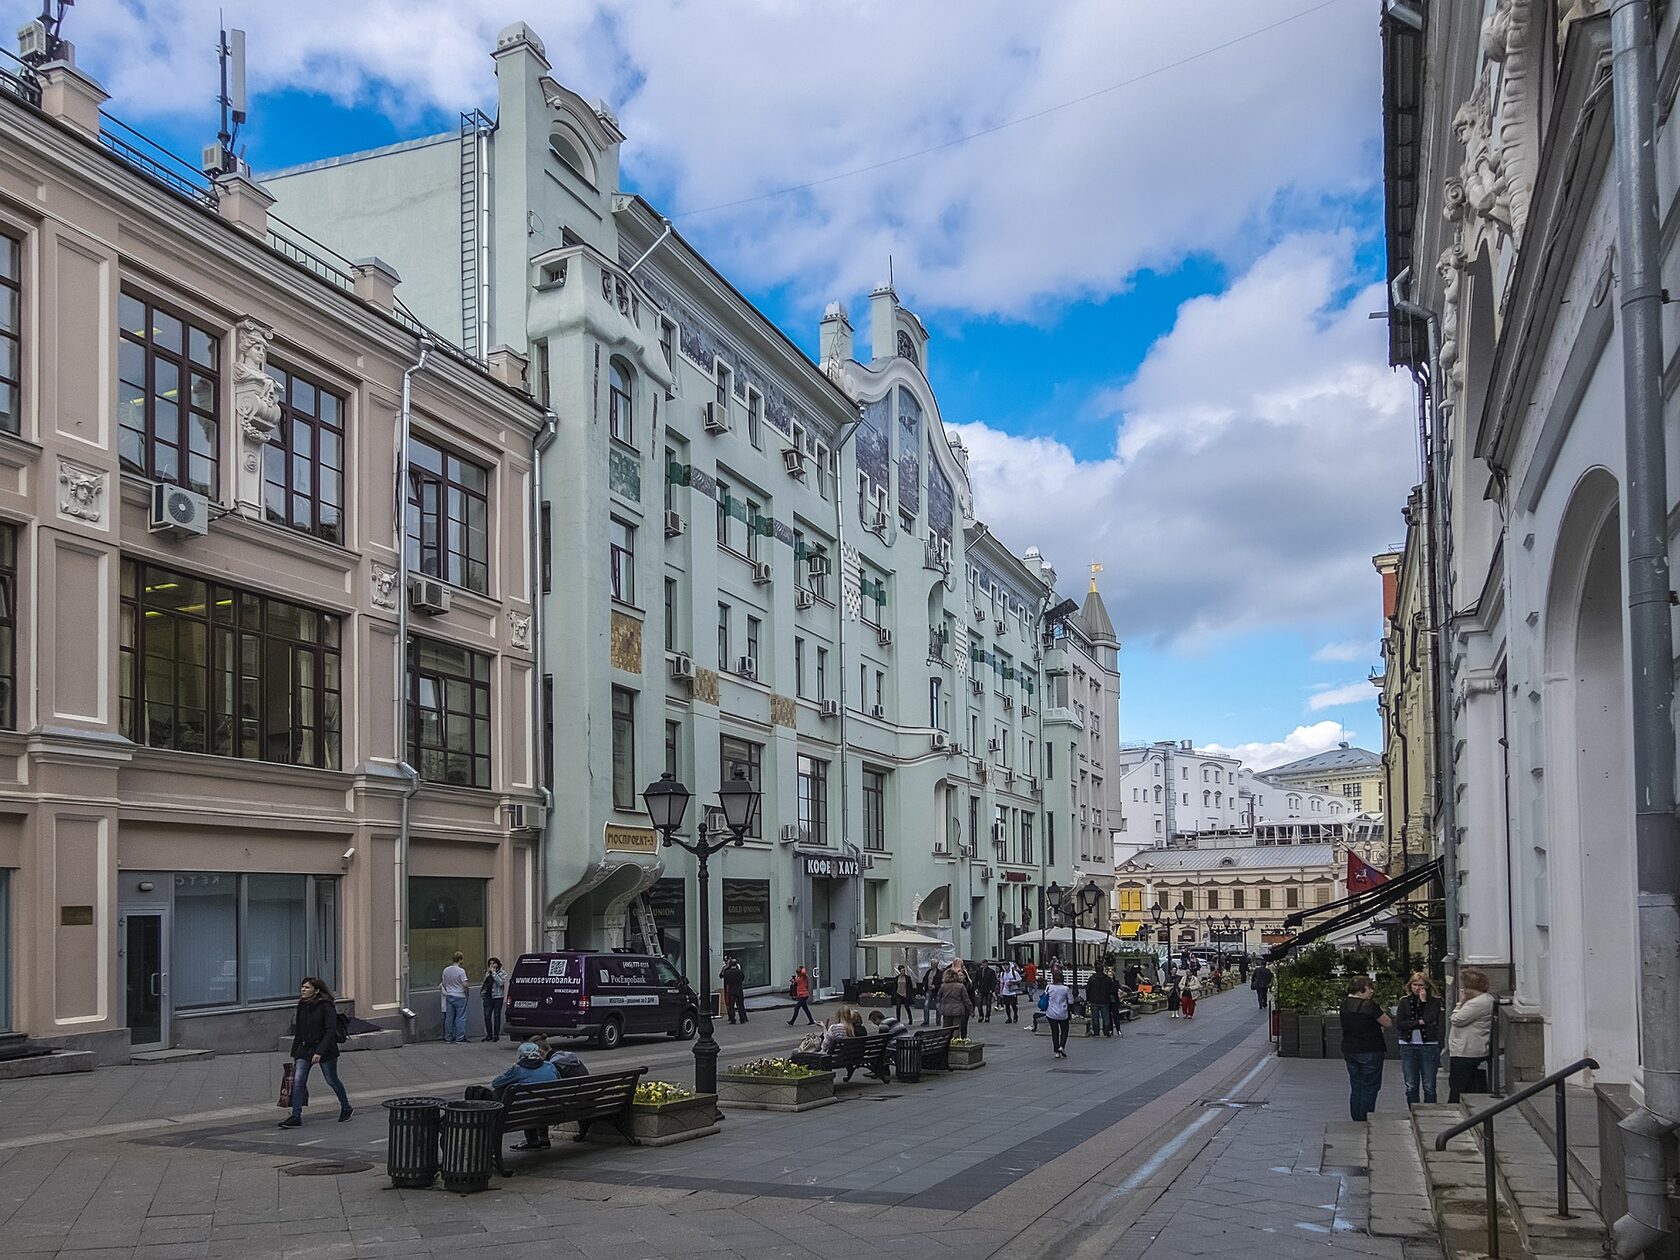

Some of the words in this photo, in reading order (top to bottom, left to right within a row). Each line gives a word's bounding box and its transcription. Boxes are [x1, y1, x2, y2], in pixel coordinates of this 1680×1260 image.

[607, 832, 654, 846] МОСПРОЕКТ-3
[807, 859, 831, 874] КОФЕ
[838, 860, 859, 875] ХАУЗ
[652, 907, 675, 916] UNION
[515, 976, 581, 985] www.rosevrobank.ru
